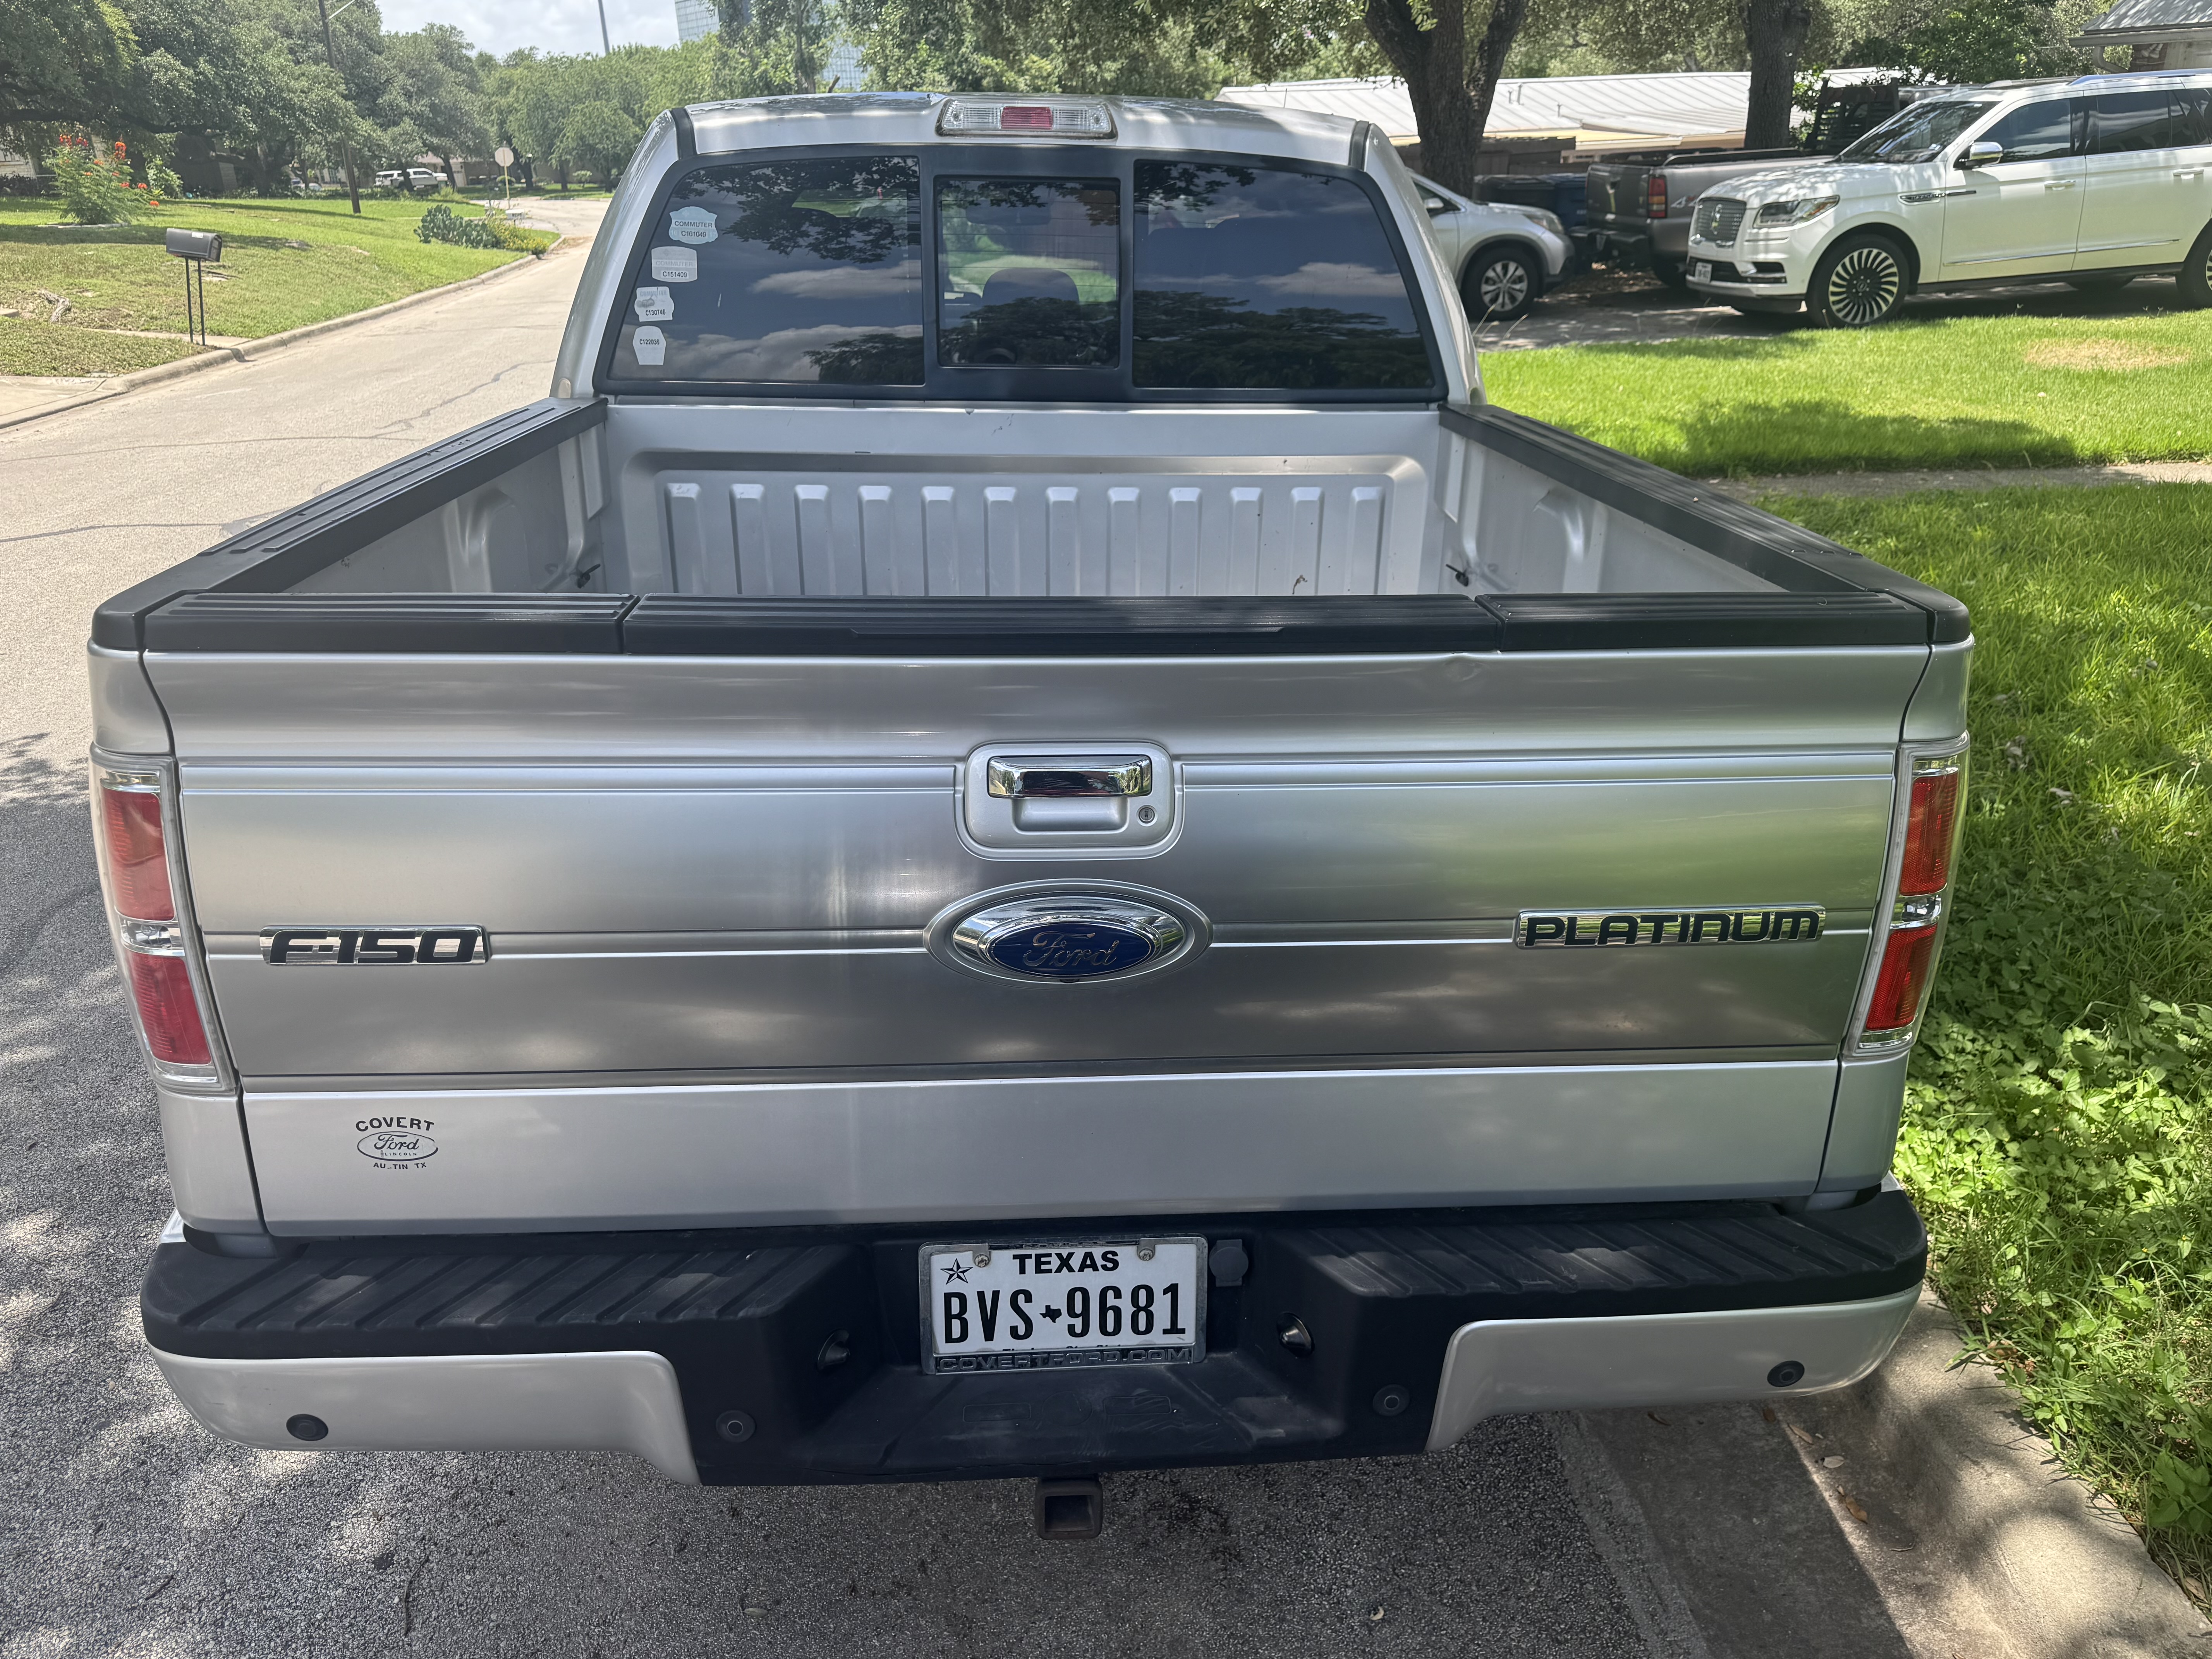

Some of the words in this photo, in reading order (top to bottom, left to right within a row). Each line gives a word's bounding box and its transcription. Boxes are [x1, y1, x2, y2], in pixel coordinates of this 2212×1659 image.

[1524, 910, 1820, 946] PLATINUM
[270, 929, 479, 964] F-150
[1022, 931, 1121, 968] Ford
[356, 1117, 434, 1132] COVERT
[374, 1133, 420, 1150] Ford
[1012, 1250, 1120, 1275] TEXAS
[939, 1348, 1190, 1372] COVERTFORD.COM
